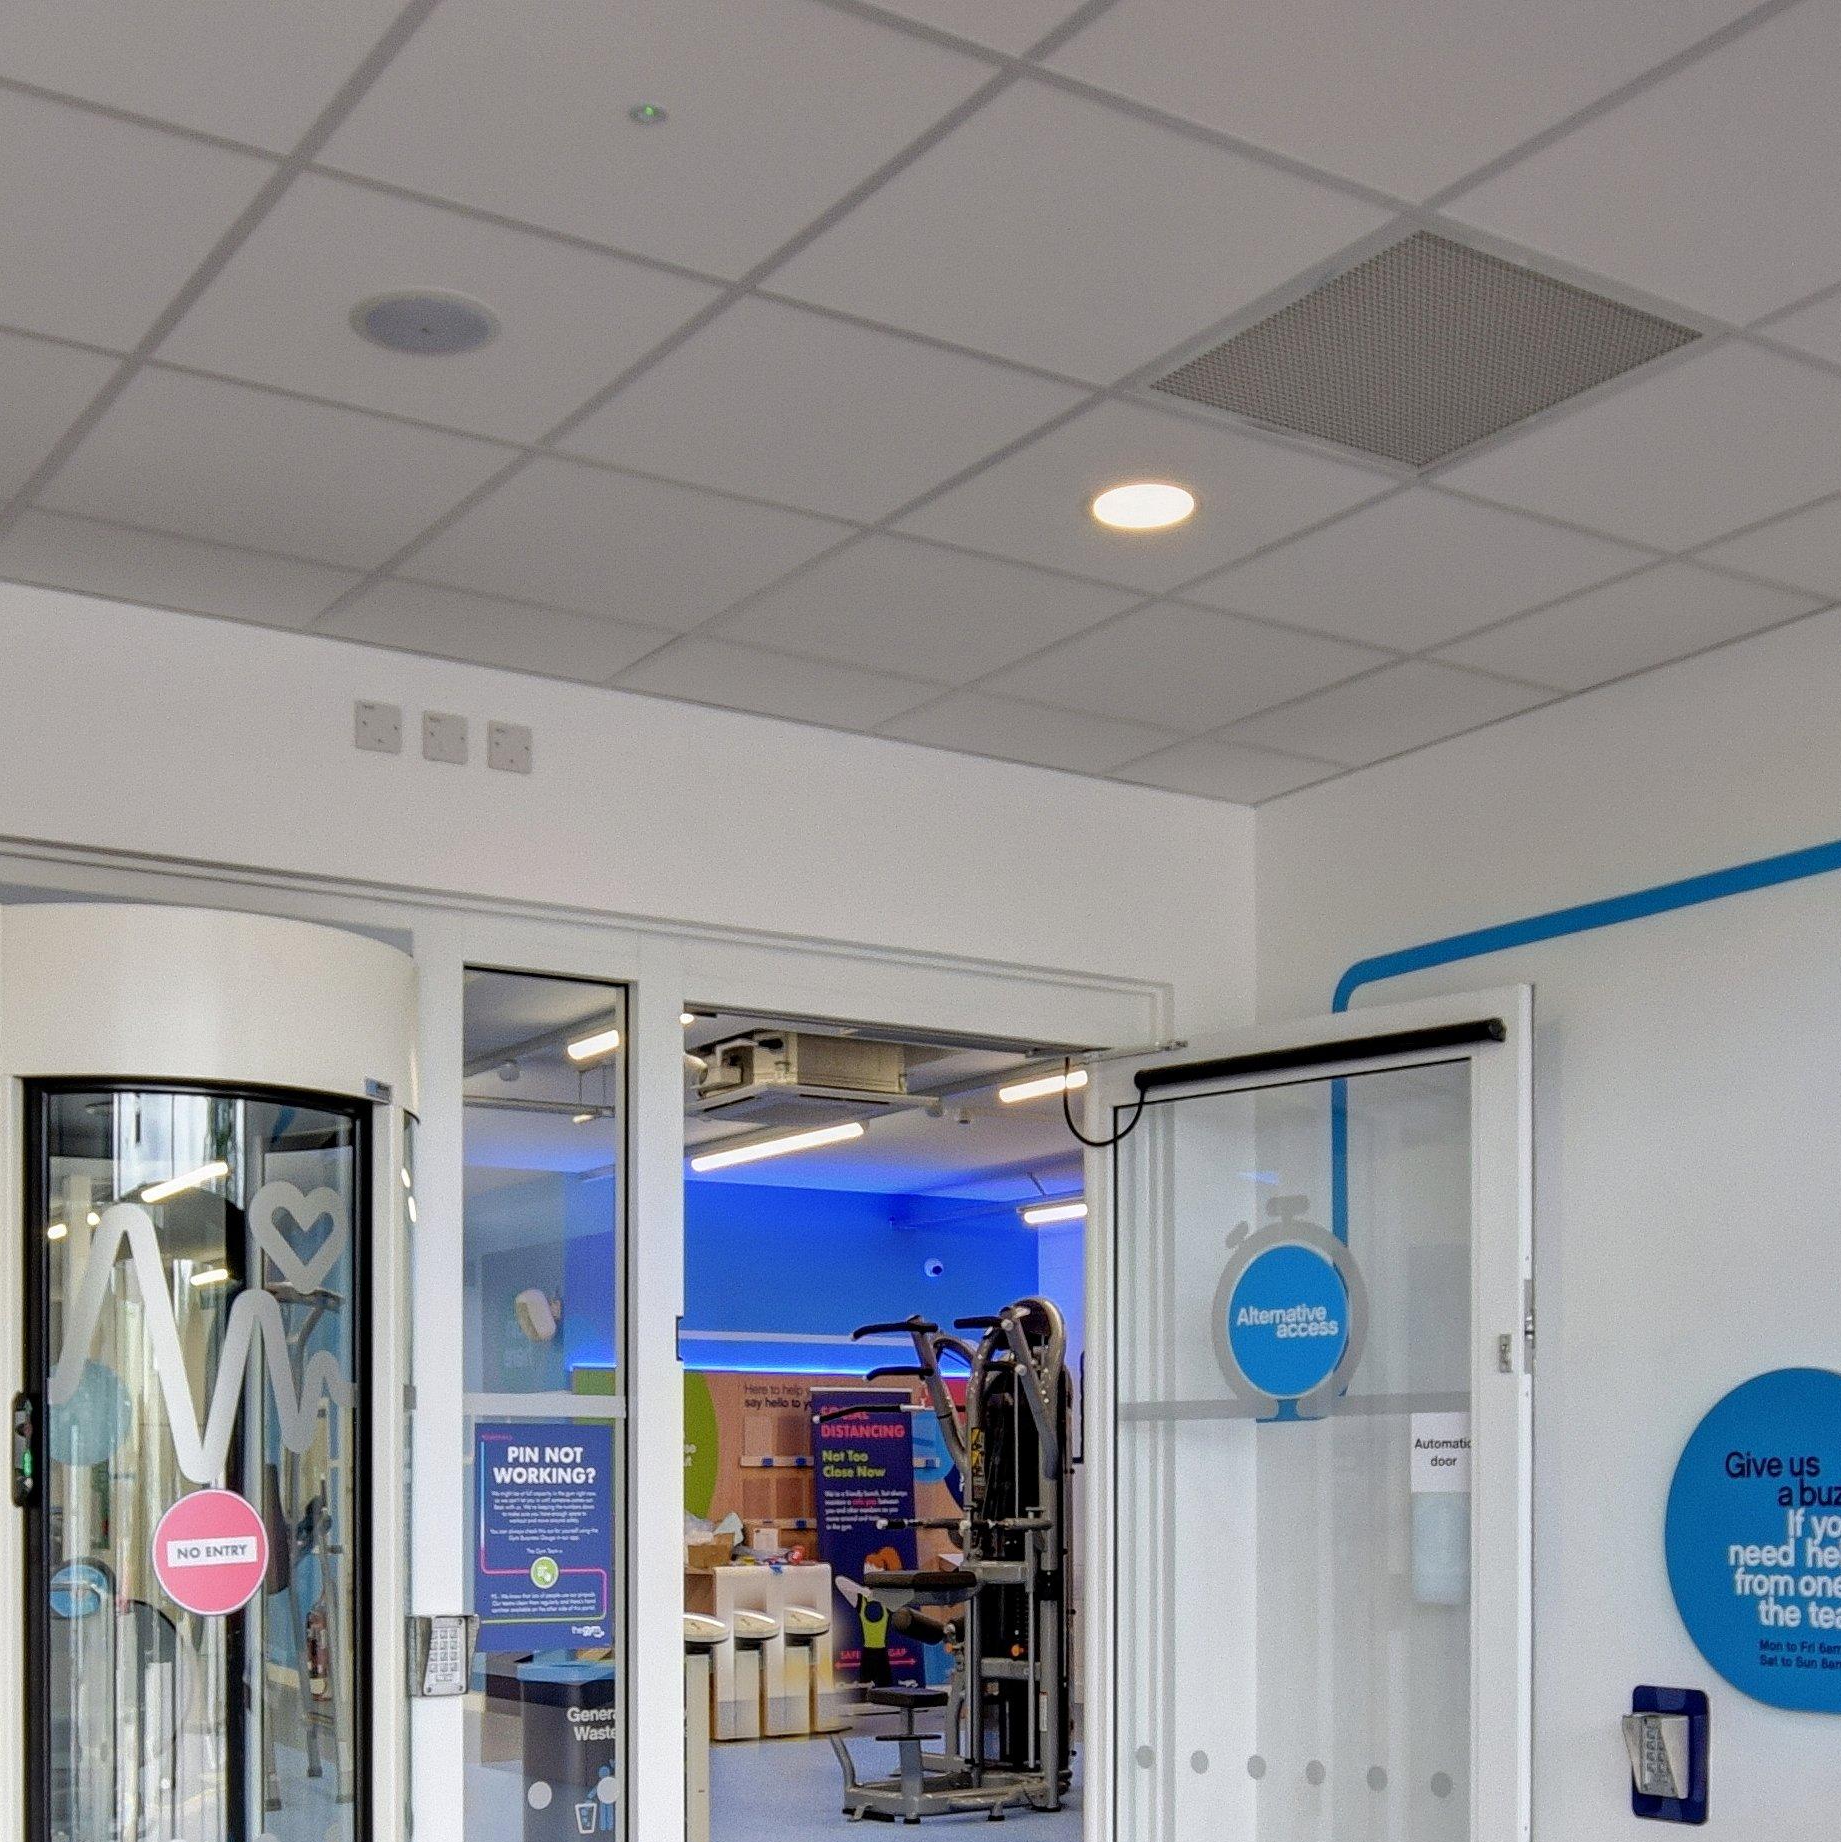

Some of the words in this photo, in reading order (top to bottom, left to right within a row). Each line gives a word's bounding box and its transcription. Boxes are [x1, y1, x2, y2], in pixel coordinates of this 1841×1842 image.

[1237, 1304, 1328, 1327] Alternative
[1277, 1320, 1339, 1339] access
[744, 1384, 768, 1395] Here
[769, 1384, 779, 1395] to
[783, 1384, 802, 1396] help
[745, 1399, 762, 1410] say
[765, 1398, 789, 1408] hello
[791, 1399, 801, 1408] to
[820, 1424, 905, 1439] DISTANCING
[507, 1446, 539, 1463] PIN
[545, 1446, 584, 1463] NOT
[822, 1450, 845, 1463] Not
[847, 1450, 868, 1463] Too
[1430, 1456, 1457, 1467] door
[822, 1466, 855, 1478] Close
[856, 1466, 886, 1478] Now
[1725, 1451, 1783, 1479] Give
[1789, 1455, 1821, 1478] us
[493, 1467, 596, 1484] WORKING?
[1777, 1486, 1794, 1507] a
[1787, 1507, 1805, 1538] If
[177, 1547, 200, 1559] NO
[206, 1544, 247, 1557] ENTRY
[1728, 1538, 1796, 1567] need
[1734, 1566, 1795, 1597] from
[1759, 1597, 1801, 1628] the
[1759, 1639, 1783, 1651] Mon
[1787, 1641, 1798, 1652] to
[1800, 1641, 1816, 1653] Fri
[1759, 1654, 1778, 1667] Sat
[1781, 1655, 1793, 1668] to
[1796, 1656, 1817, 1669] Sun
[567, 1706, 615, 1722] Gener
